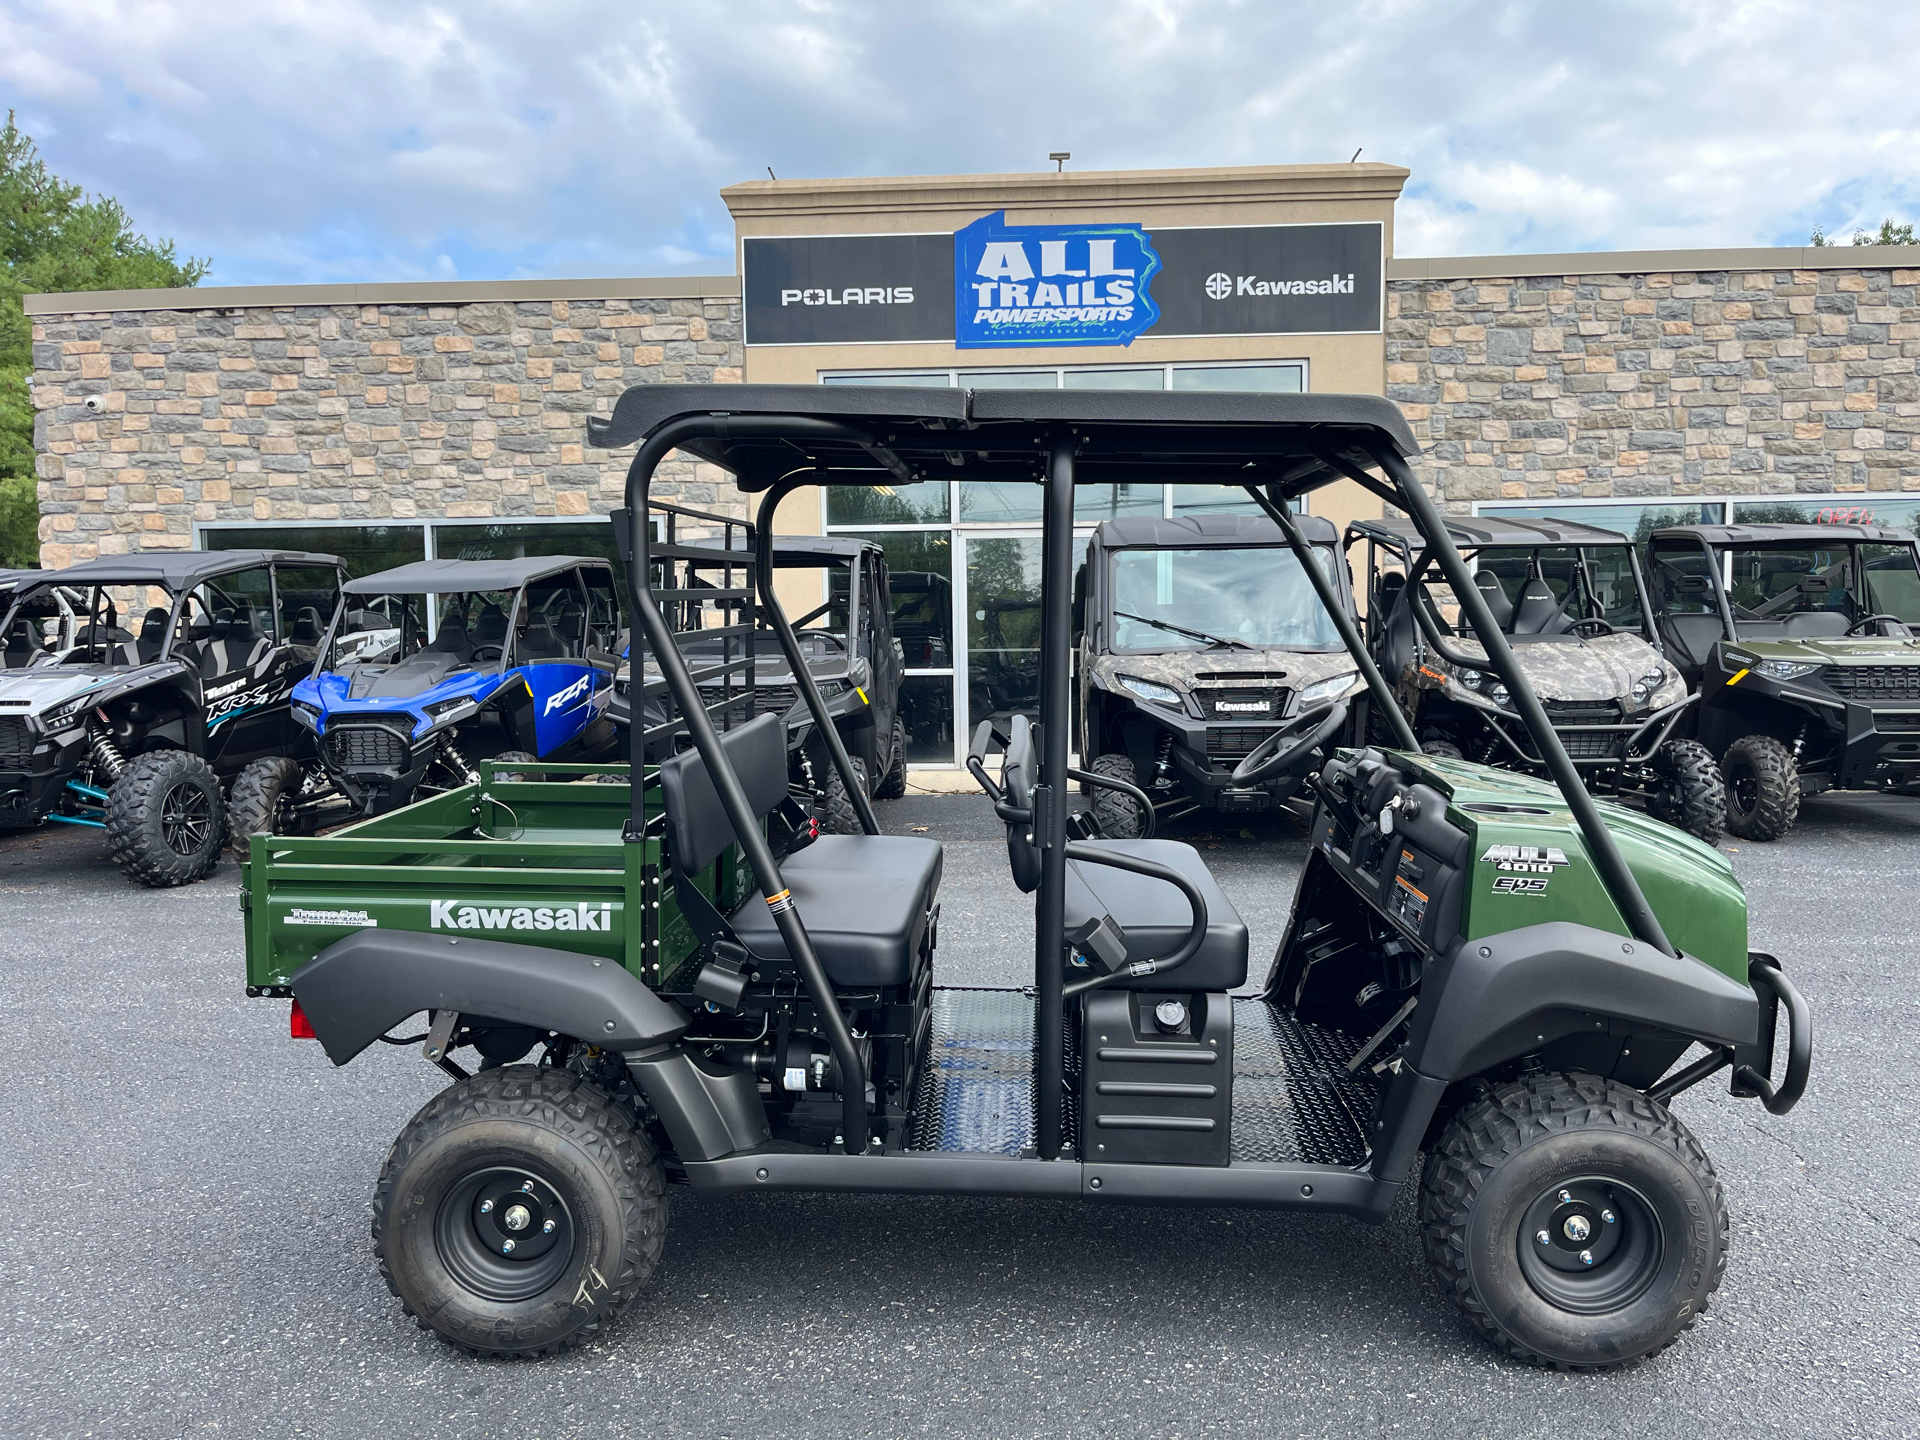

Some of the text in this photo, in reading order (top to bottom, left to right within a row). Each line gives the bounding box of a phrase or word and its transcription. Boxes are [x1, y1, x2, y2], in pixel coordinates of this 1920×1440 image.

[976, 239, 1134, 282] ALL
[972, 279, 1135, 307] TRAILS
[1236, 274, 1354, 296] Kawasaki
[781, 287, 914, 306] POLARIS
[973, 306, 1134, 324] POWERSPORTS
[457, 546, 495, 560] Ninja
[543, 674, 590, 717] RZR
[1215, 701, 1270, 711] Kawasaki
[1480, 844, 1571, 867] MULE
[1497, 862, 1554, 873] 4010
[430, 899, 612, 931] Kawasaki
[1685, 1198, 1708, 1290] DURO
